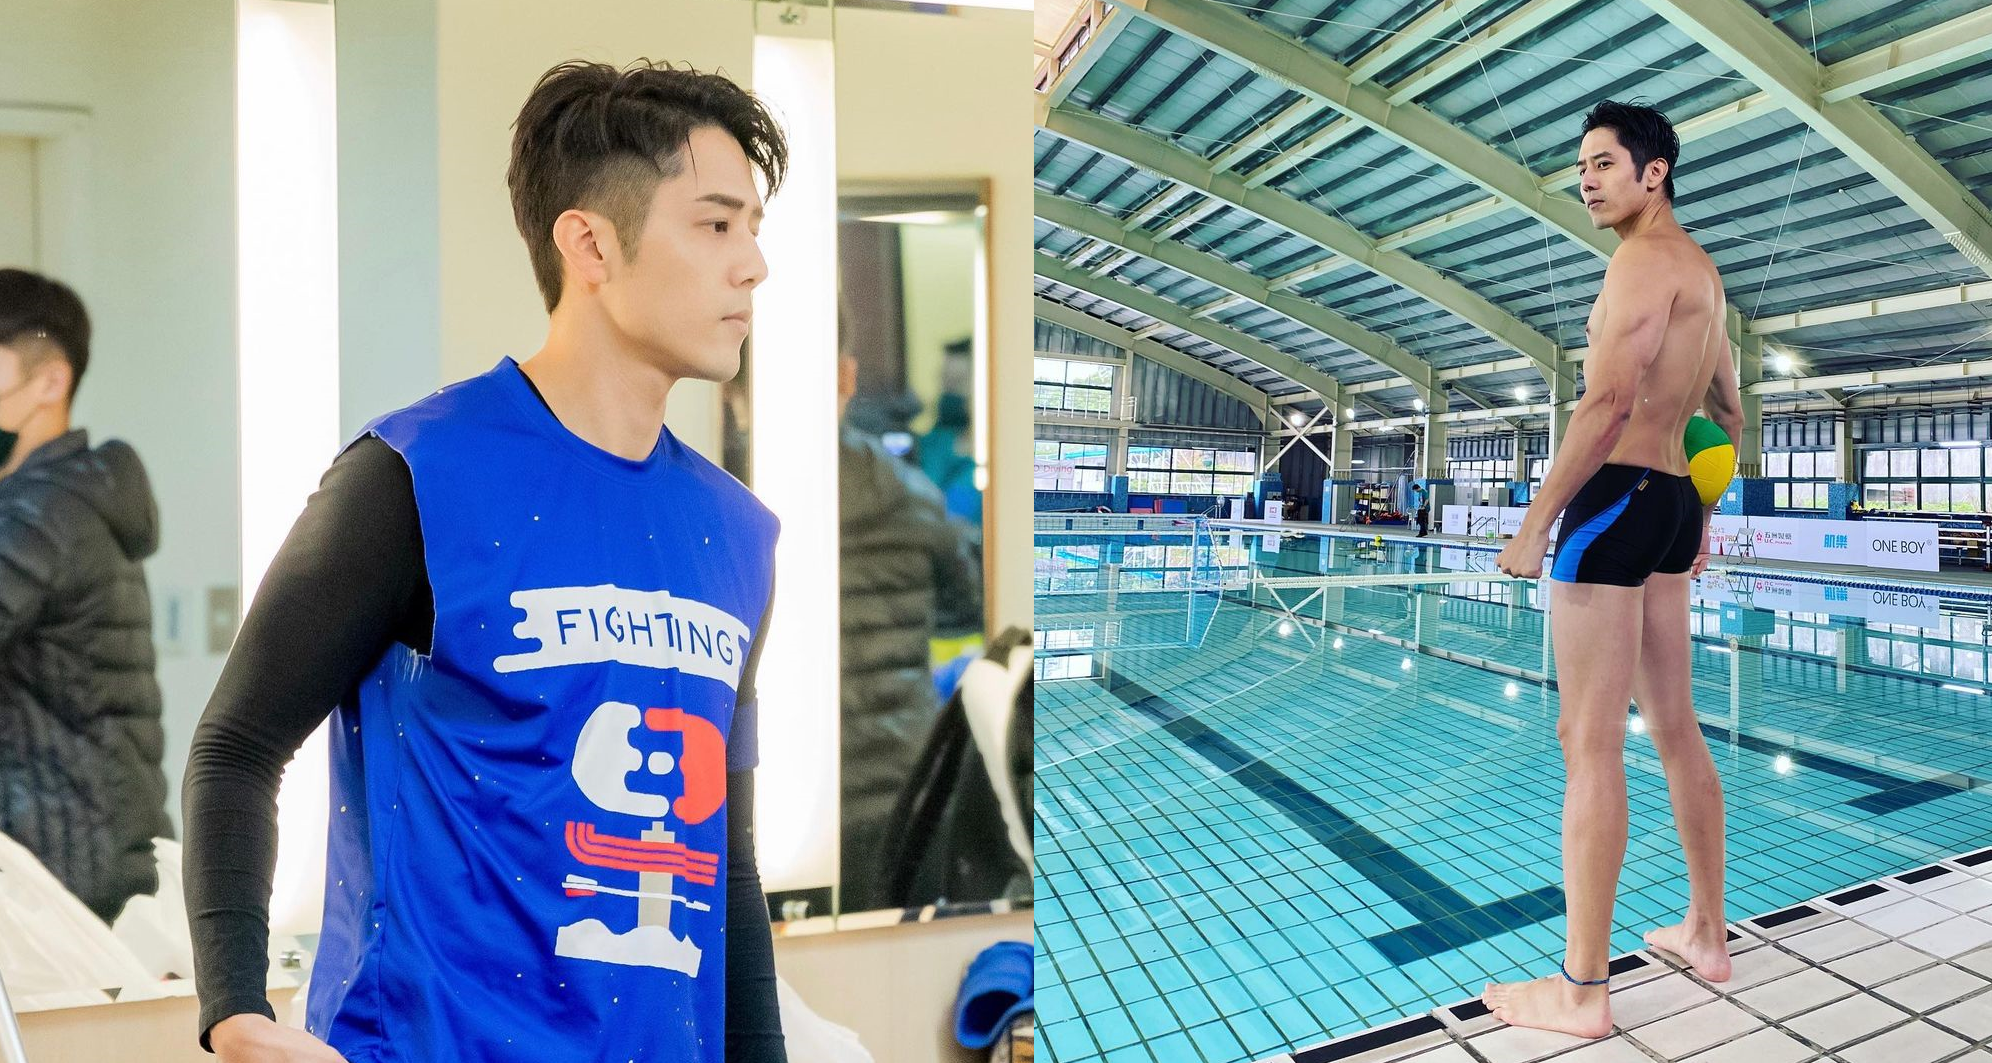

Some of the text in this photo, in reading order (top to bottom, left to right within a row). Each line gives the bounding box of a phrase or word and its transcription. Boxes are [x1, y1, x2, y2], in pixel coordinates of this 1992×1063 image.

[1044, 465, 1073, 474] Diving
[1824, 534, 1848, 549] 肌樂
[1872, 539, 1926, 554] ONE BOY
[556, 606, 733, 665] FIGHTING
